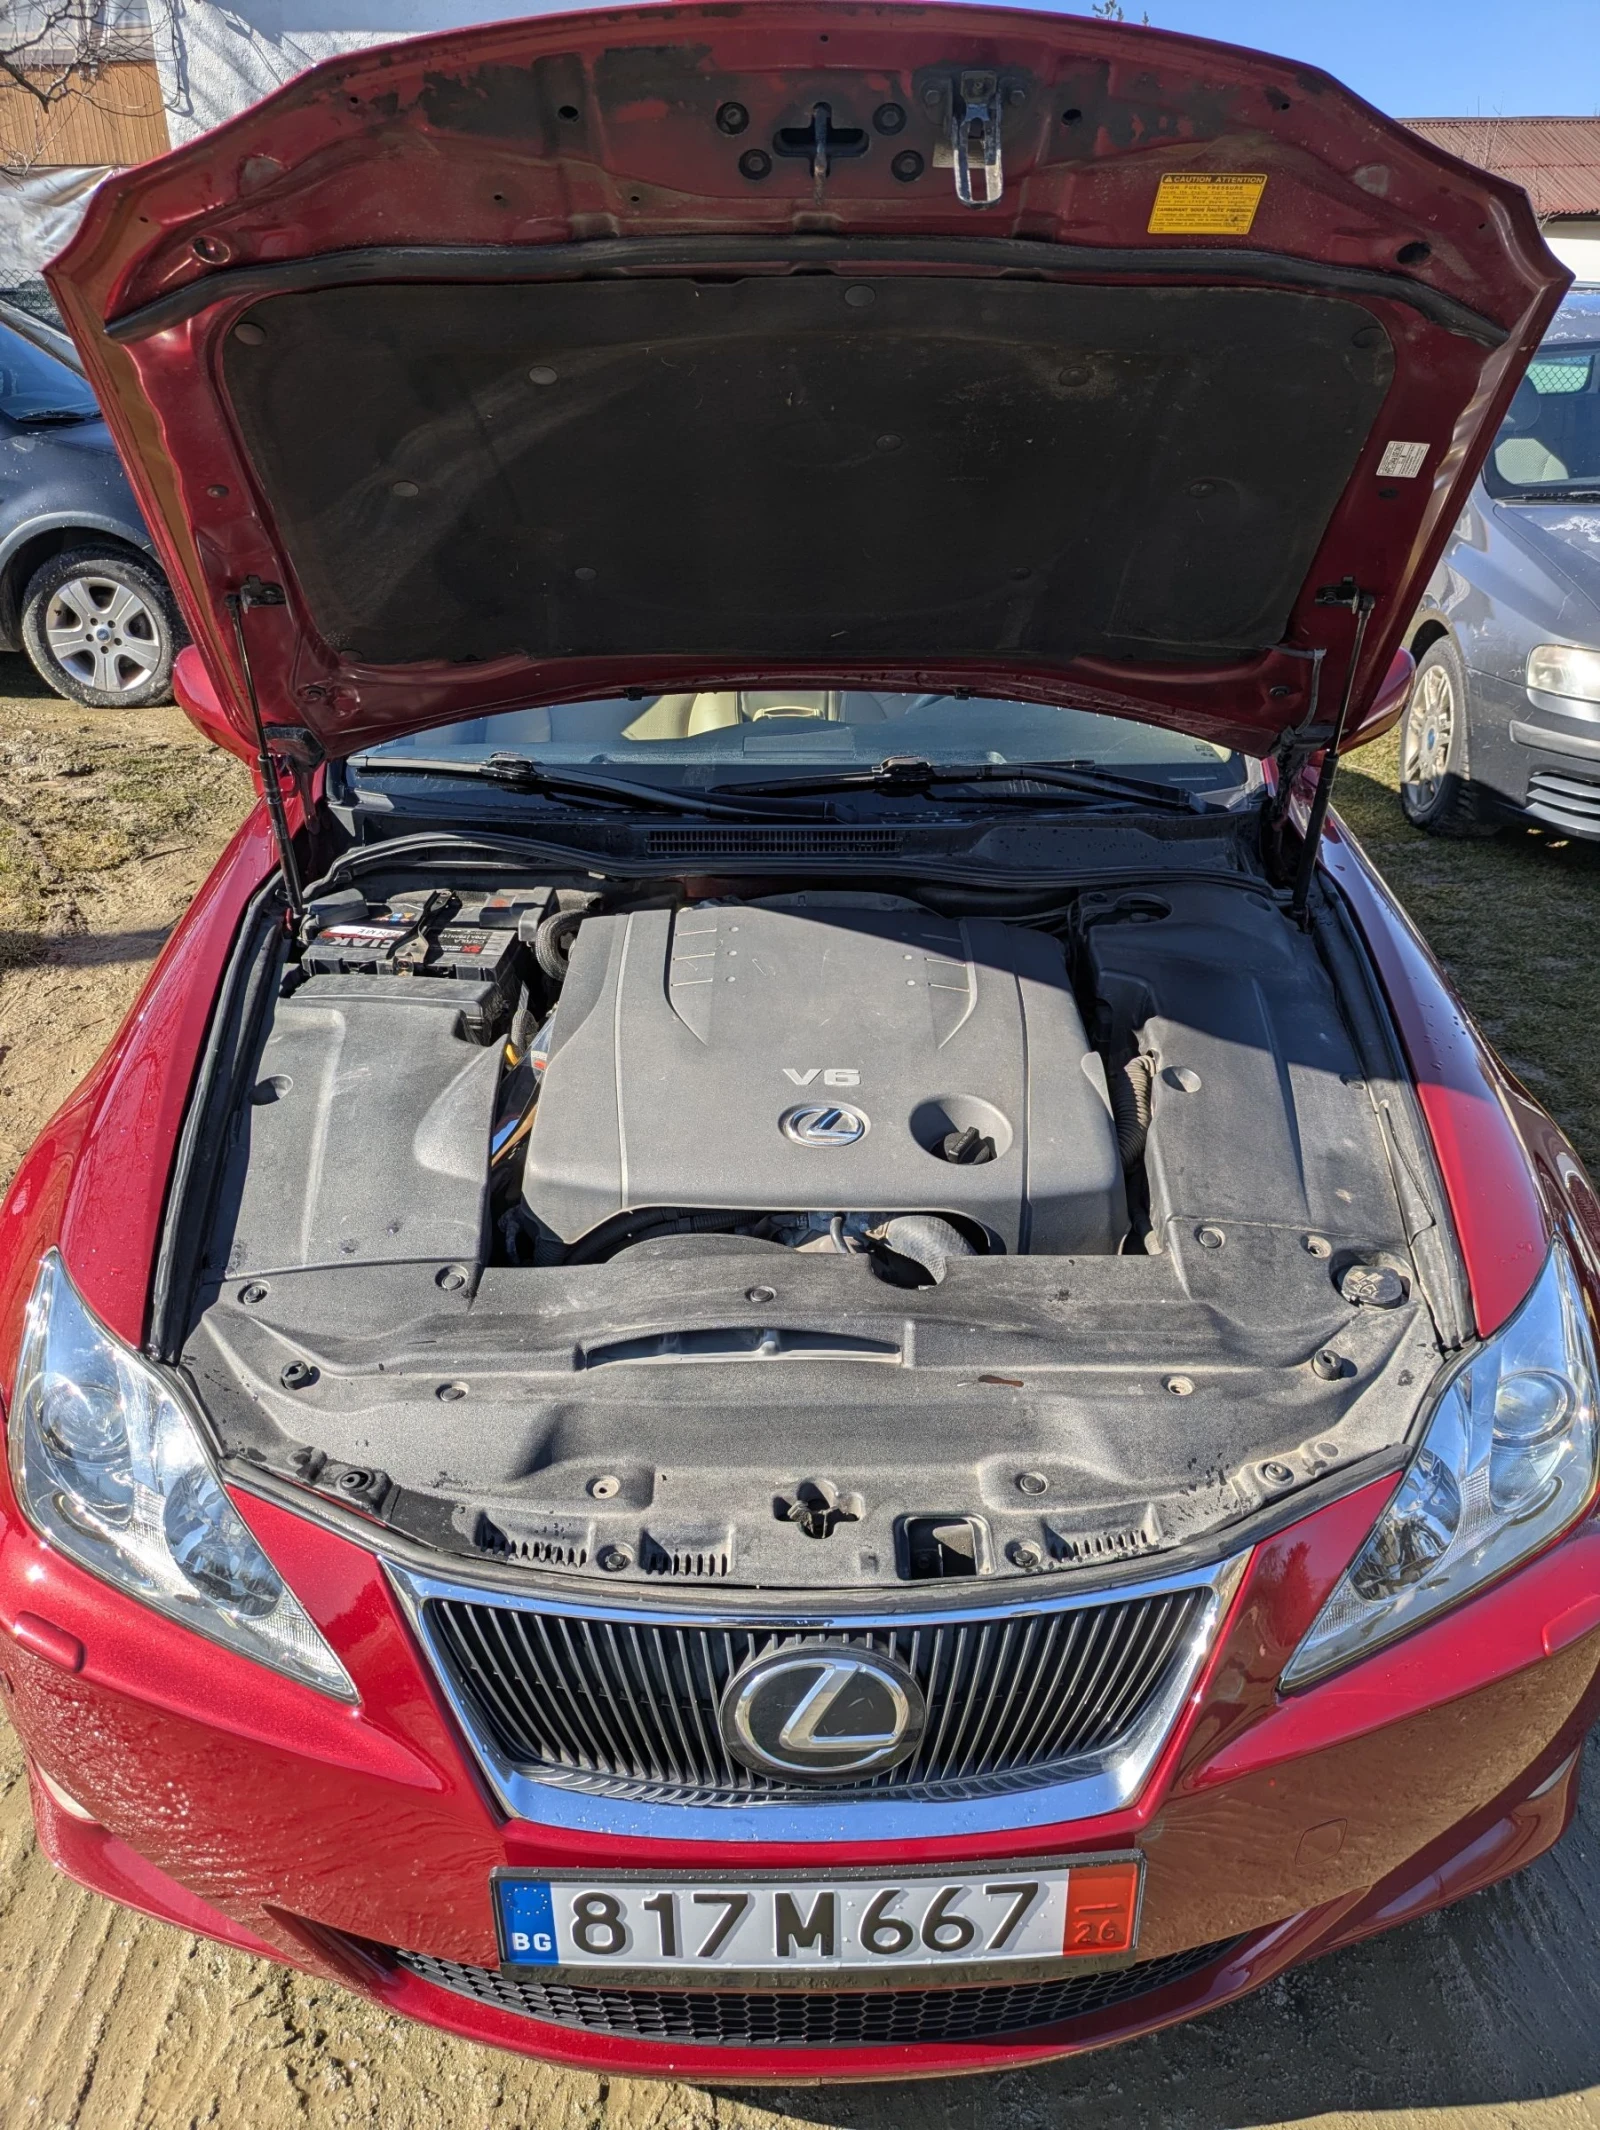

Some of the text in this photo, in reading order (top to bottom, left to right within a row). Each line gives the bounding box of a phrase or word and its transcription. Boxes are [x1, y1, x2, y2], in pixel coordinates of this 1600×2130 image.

[1215, 176, 1263, 184] ATTENTION
[332, 936, 393, 949] CIAK
[782, 1068, 861, 1086] V6
[571, 1882, 1039, 1957] 817 M 667
[1073, 1919, 1116, 1943] 26
[512, 1933, 552, 1952] BG
